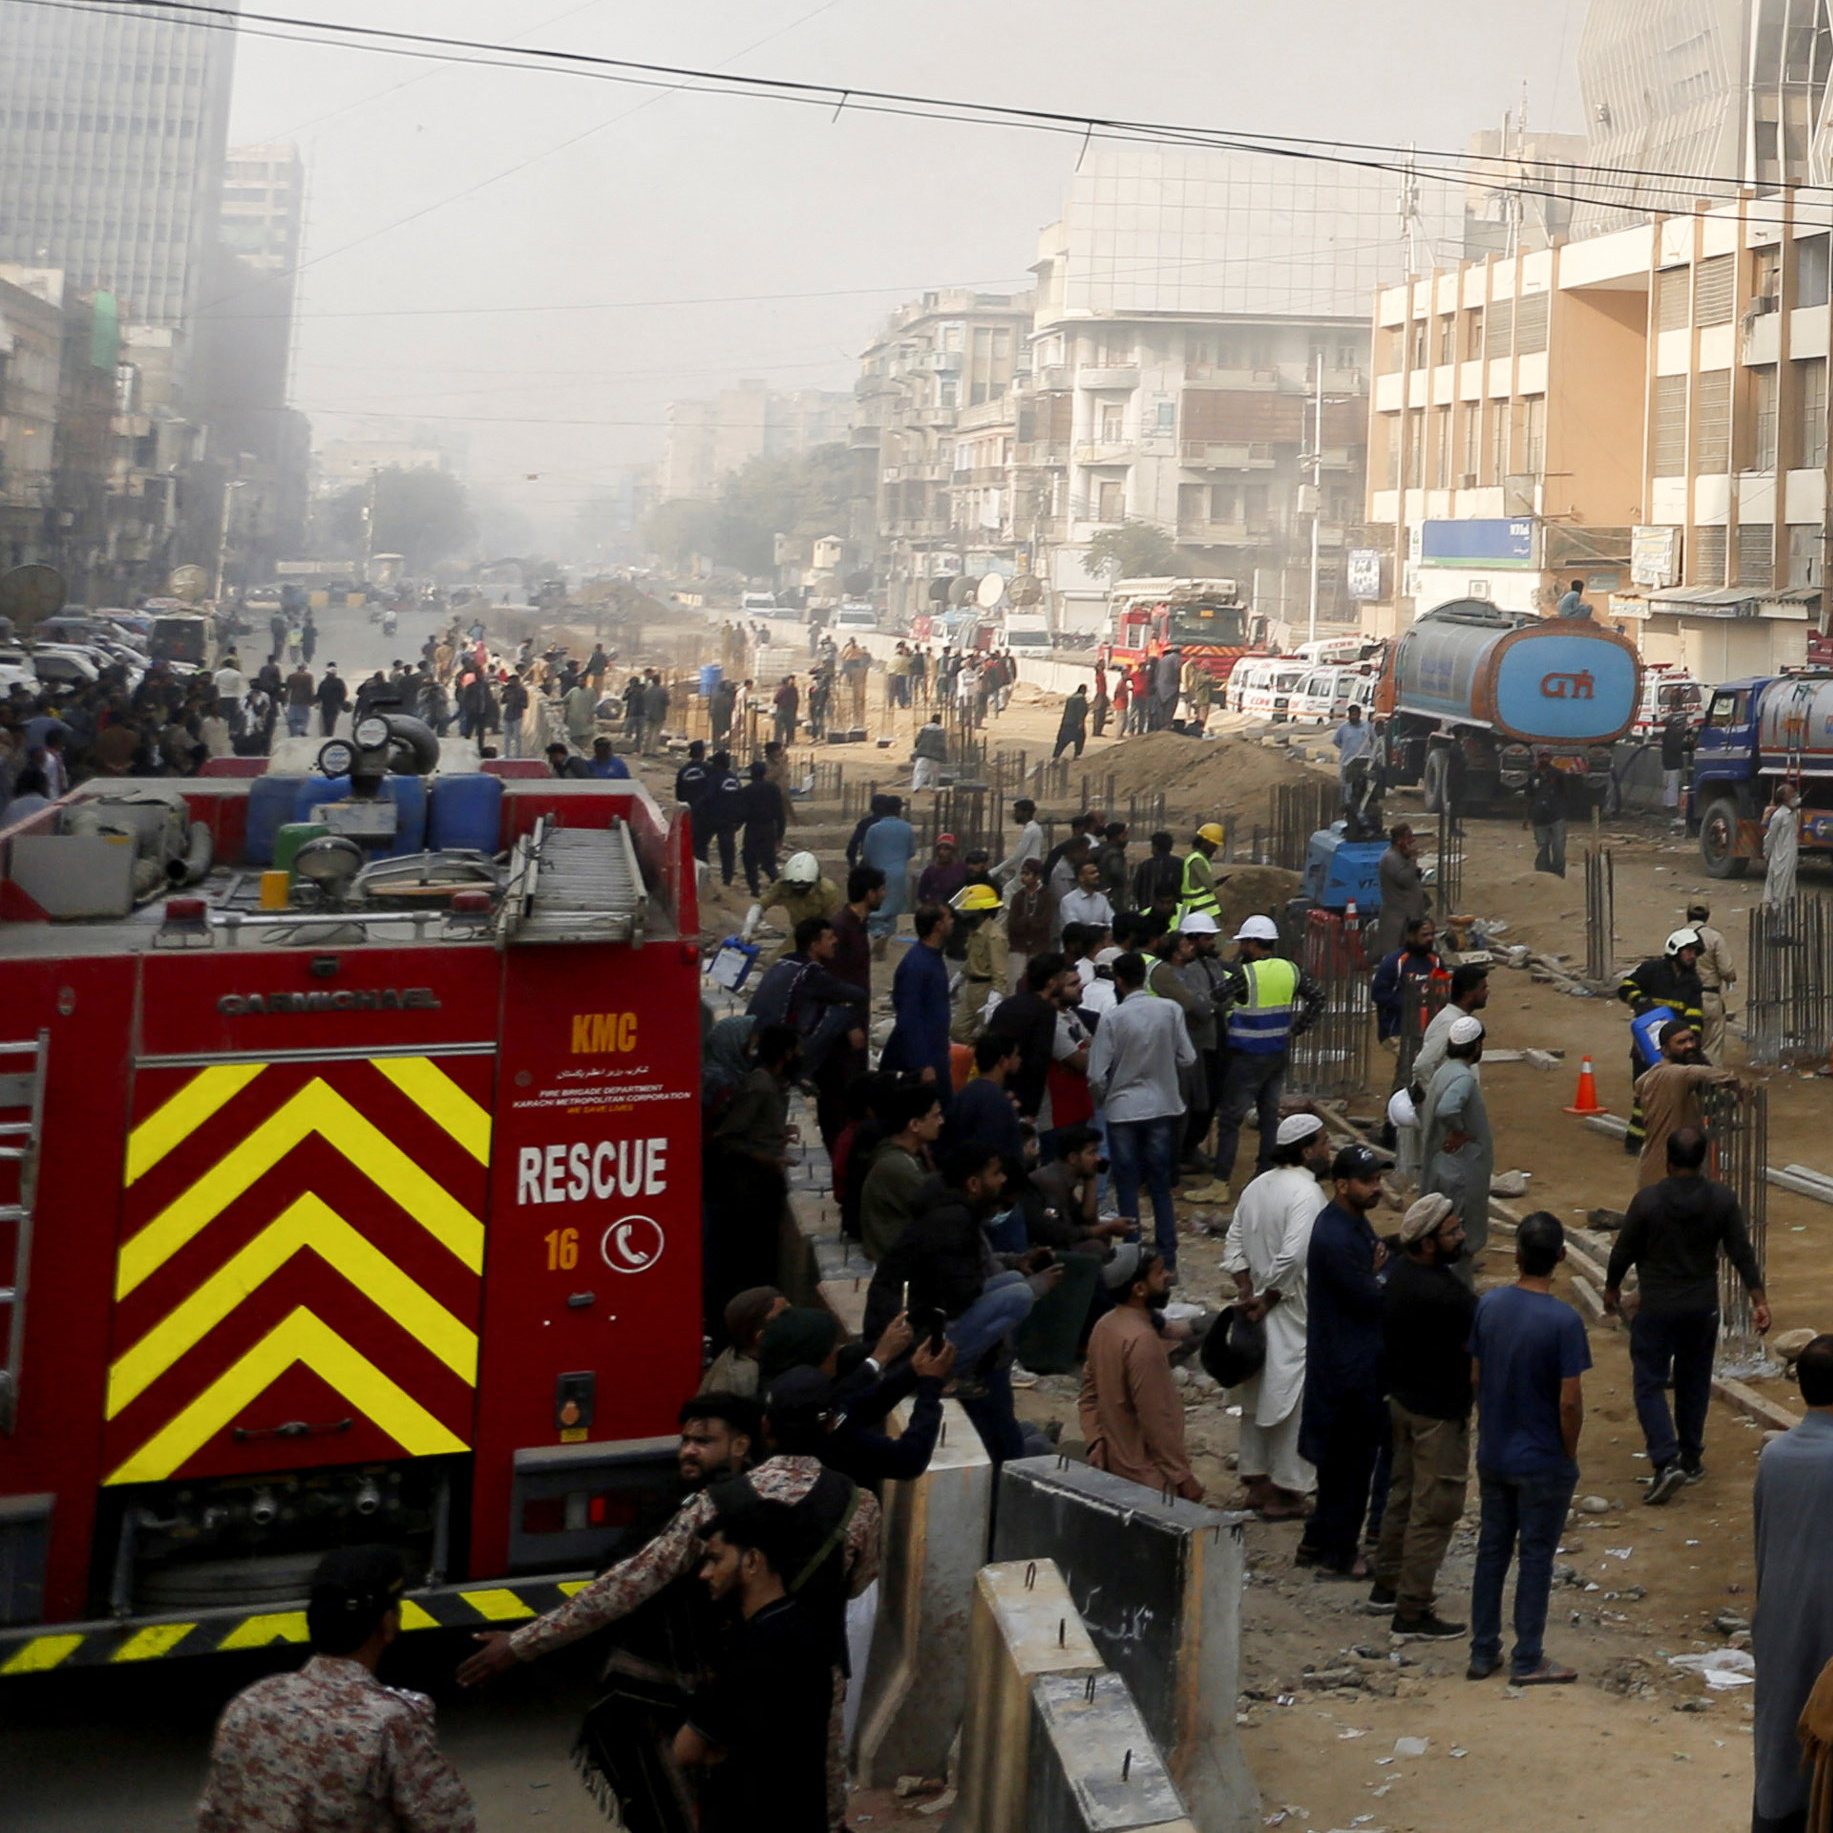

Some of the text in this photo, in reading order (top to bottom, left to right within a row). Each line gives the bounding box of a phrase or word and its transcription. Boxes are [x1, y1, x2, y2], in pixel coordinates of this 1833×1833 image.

[217, 987, 442, 1016] CARMICHAEL
[570, 1012, 638, 1054] KMC
[512, 1091, 692, 1109] KARACHI METROPOLITAN CORPORATION
[561, 1087, 602, 1097] BRIGADE
[603, 1084, 664, 1095] DEPARTMENT
[517, 1137, 669, 1206] RESCUE
[544, 1227, 580, 1271] 16
